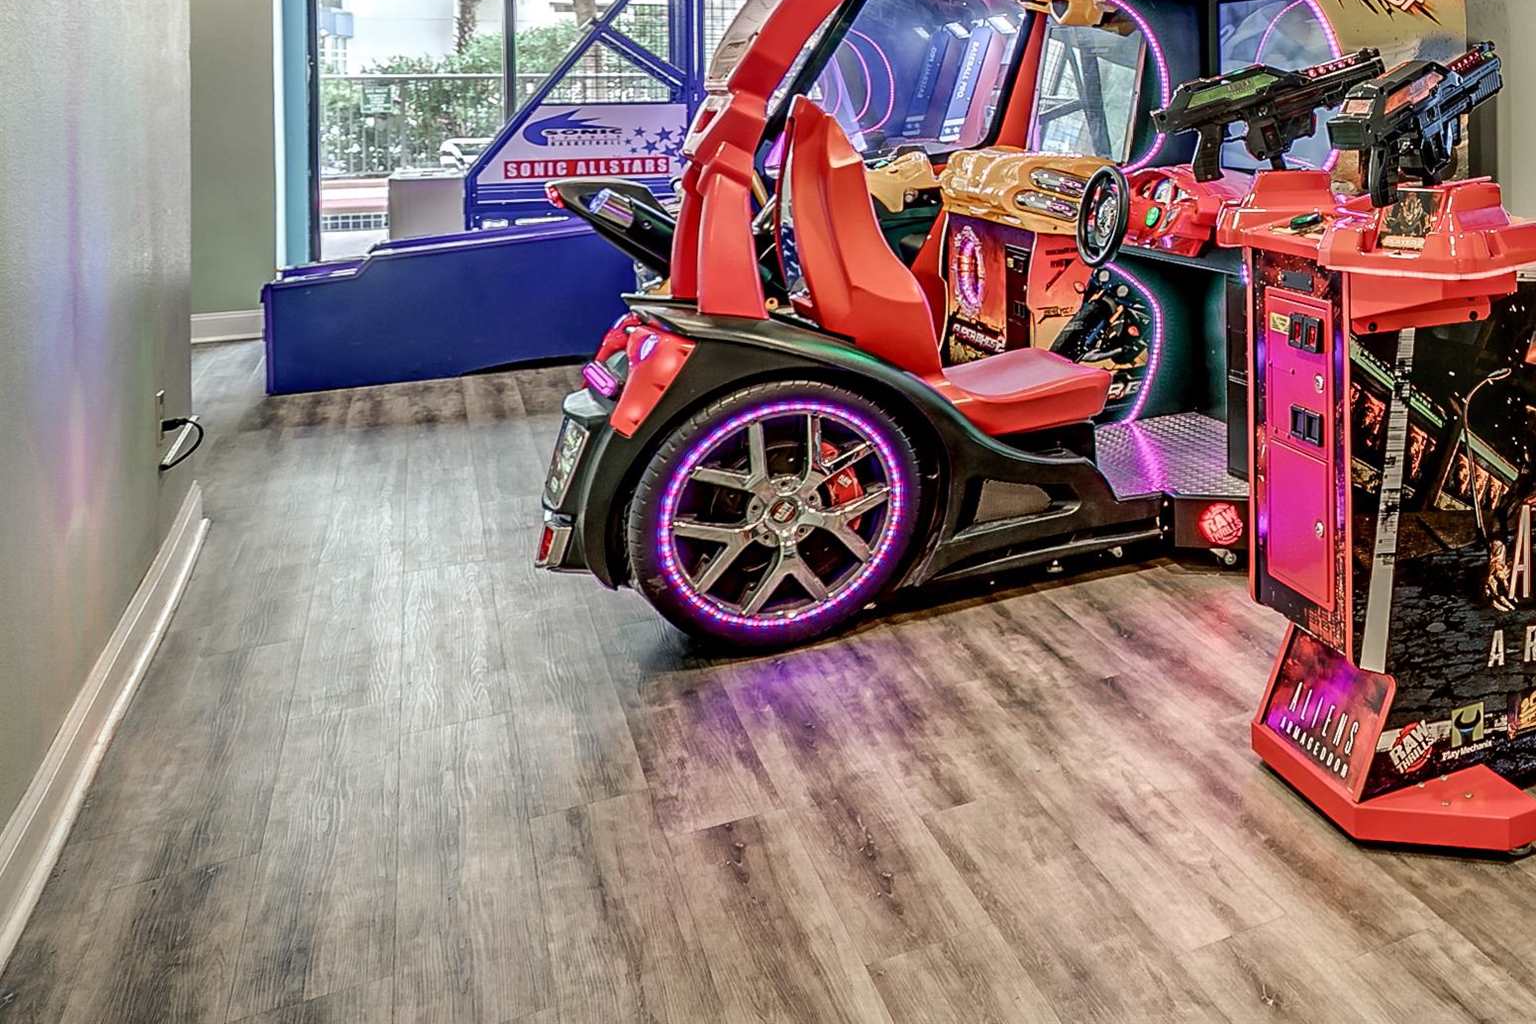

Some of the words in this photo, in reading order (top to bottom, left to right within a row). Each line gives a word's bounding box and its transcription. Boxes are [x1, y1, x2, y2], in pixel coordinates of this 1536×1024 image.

[545, 128, 622, 136] SONIC
[506, 160, 570, 176] SONIC
[576, 158, 669, 175] ALLSTARS
[1289, 681, 1359, 756] ALIENS
[1280, 716, 1349, 778] ARMAGEDDON
[1389, 719, 1431, 764] RAW
[1396, 735, 1438, 774] THRILLS
